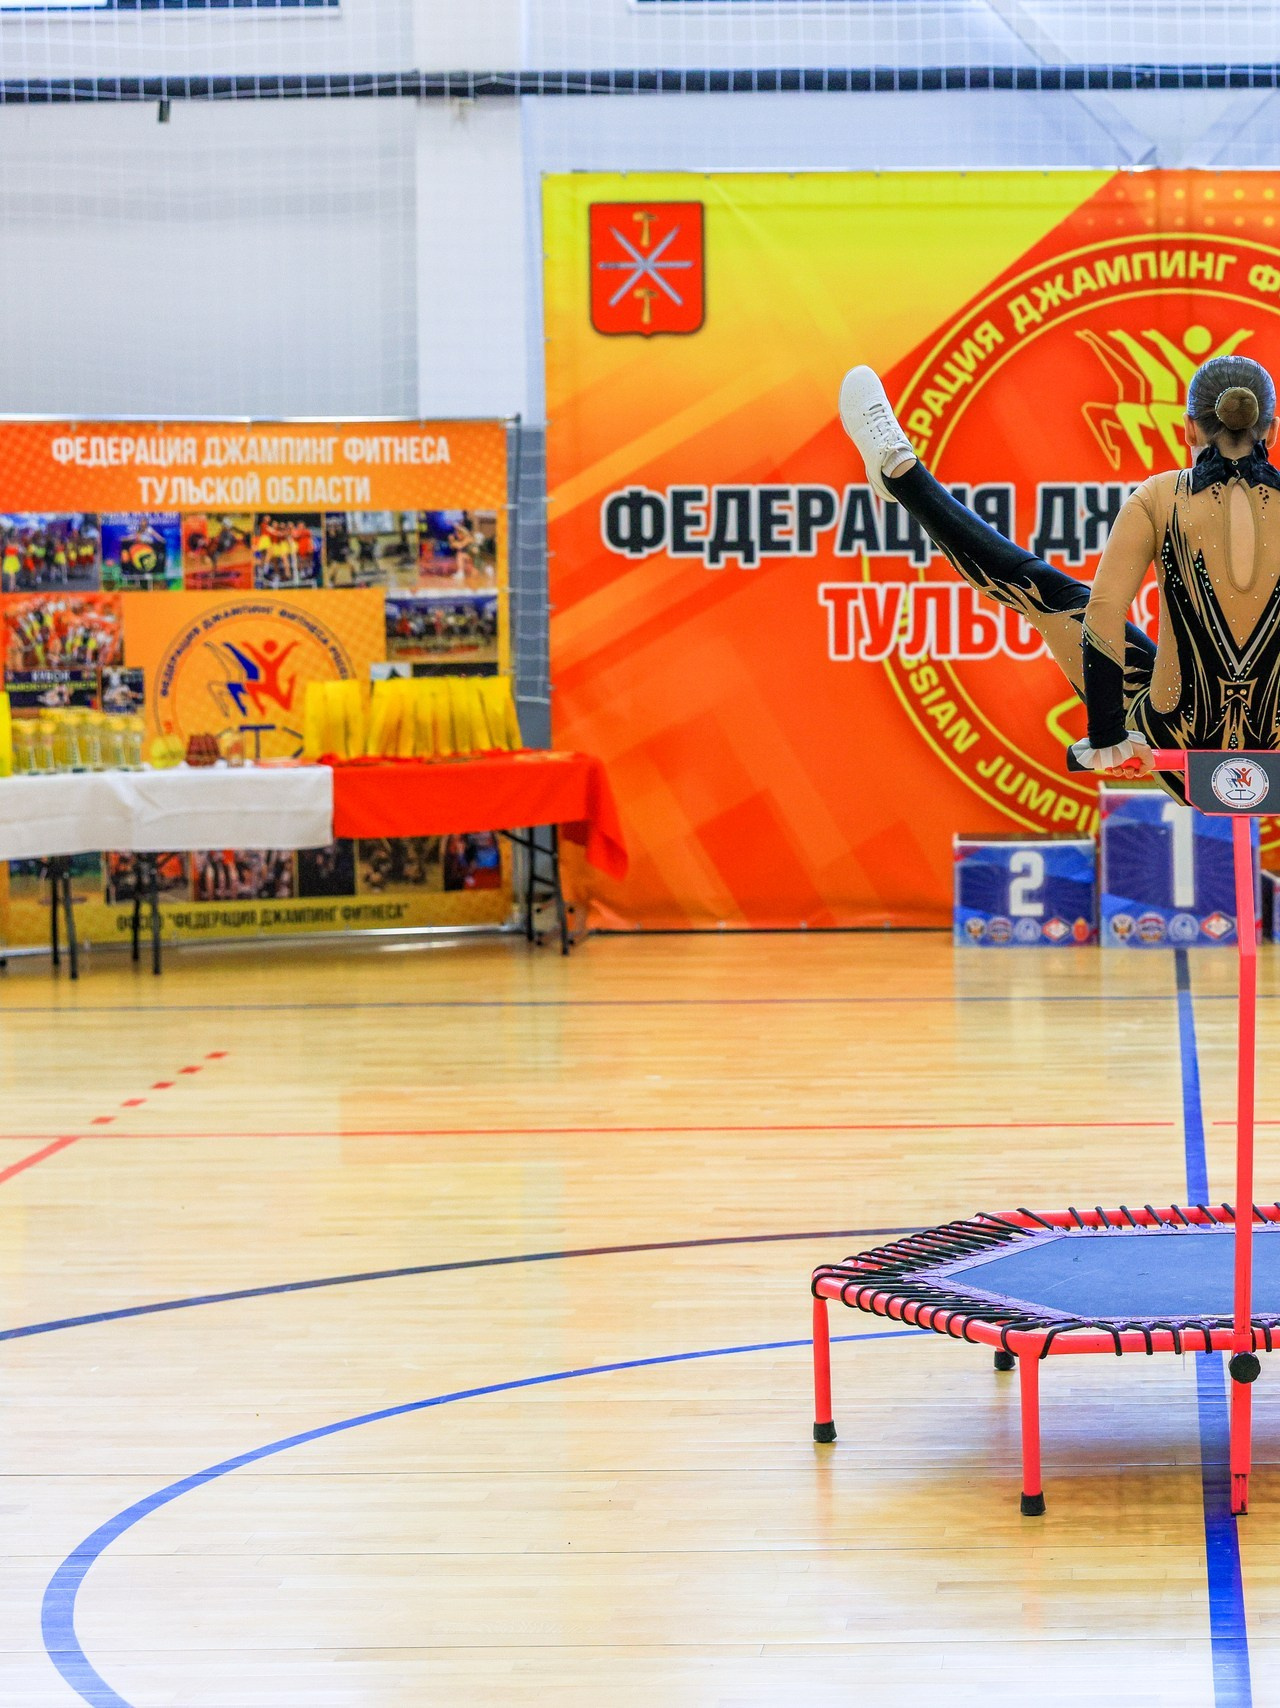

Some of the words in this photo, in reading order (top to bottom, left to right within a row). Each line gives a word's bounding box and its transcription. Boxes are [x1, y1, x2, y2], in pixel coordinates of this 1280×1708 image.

[905, 319, 1004, 467] ЕРАЦИЯ
[1007, 250, 1237, 334] ДЖАМПИНГ
[51, 437, 197, 467] ФЕДЕРАЦИЯ
[202, 437, 339, 466] ДЖАМПИНГ
[343, 436, 450, 464] ФИТНЕСА
[138, 472, 260, 505] ТУЛЬСКОЙ
[266, 476, 370, 504] ОБЛАСТИ
[603, 483, 1014, 566] ФЕДЕРАЦЯ
[819, 580, 1160, 662] ТУЛЬС
[976, 756, 1099, 834] JUMPI
[1009, 851, 1044, 917] 2
[1161, 802, 1194, 908] 1
